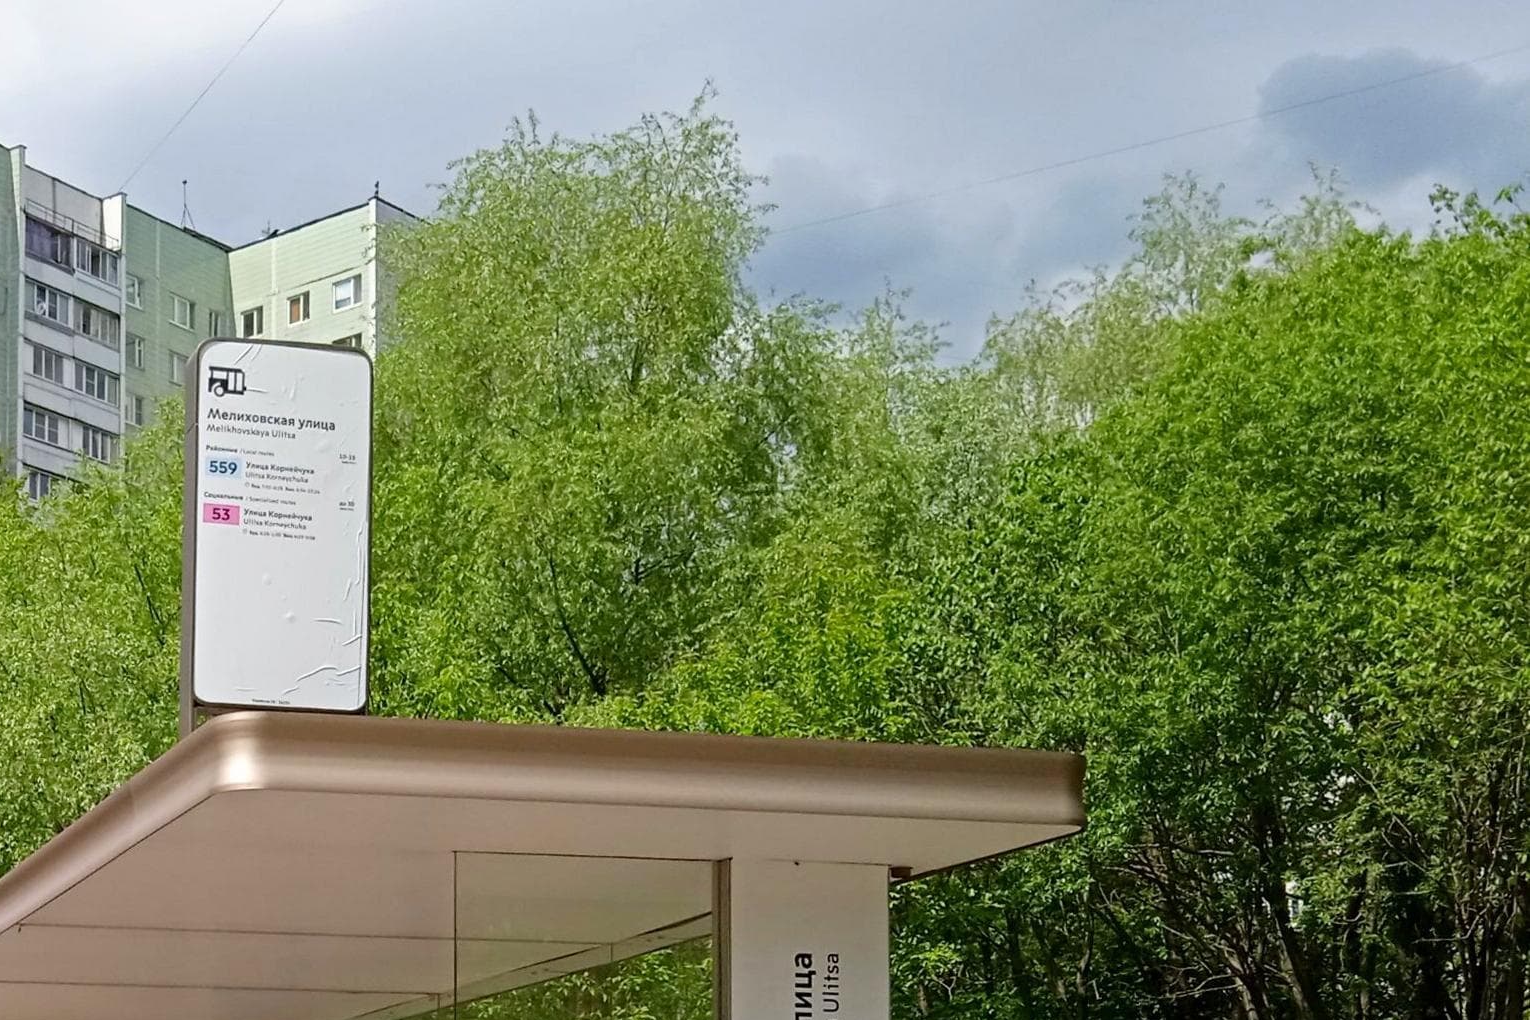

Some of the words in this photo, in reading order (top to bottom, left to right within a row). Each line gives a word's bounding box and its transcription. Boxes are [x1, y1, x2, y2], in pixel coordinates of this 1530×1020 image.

[207, 408, 295, 427] Мелиховская
[298, 418, 337, 432] улица
[206, 424, 270, 439] Melikhovskaya
[271, 430, 296, 440] Ulitsa
[209, 460, 238, 475] 559
[245, 461, 269, 472] Улица
[212, 507, 231, 521] 53
[244, 508, 267, 518] Улица
[822, 953, 840, 1013] Ulitsa
